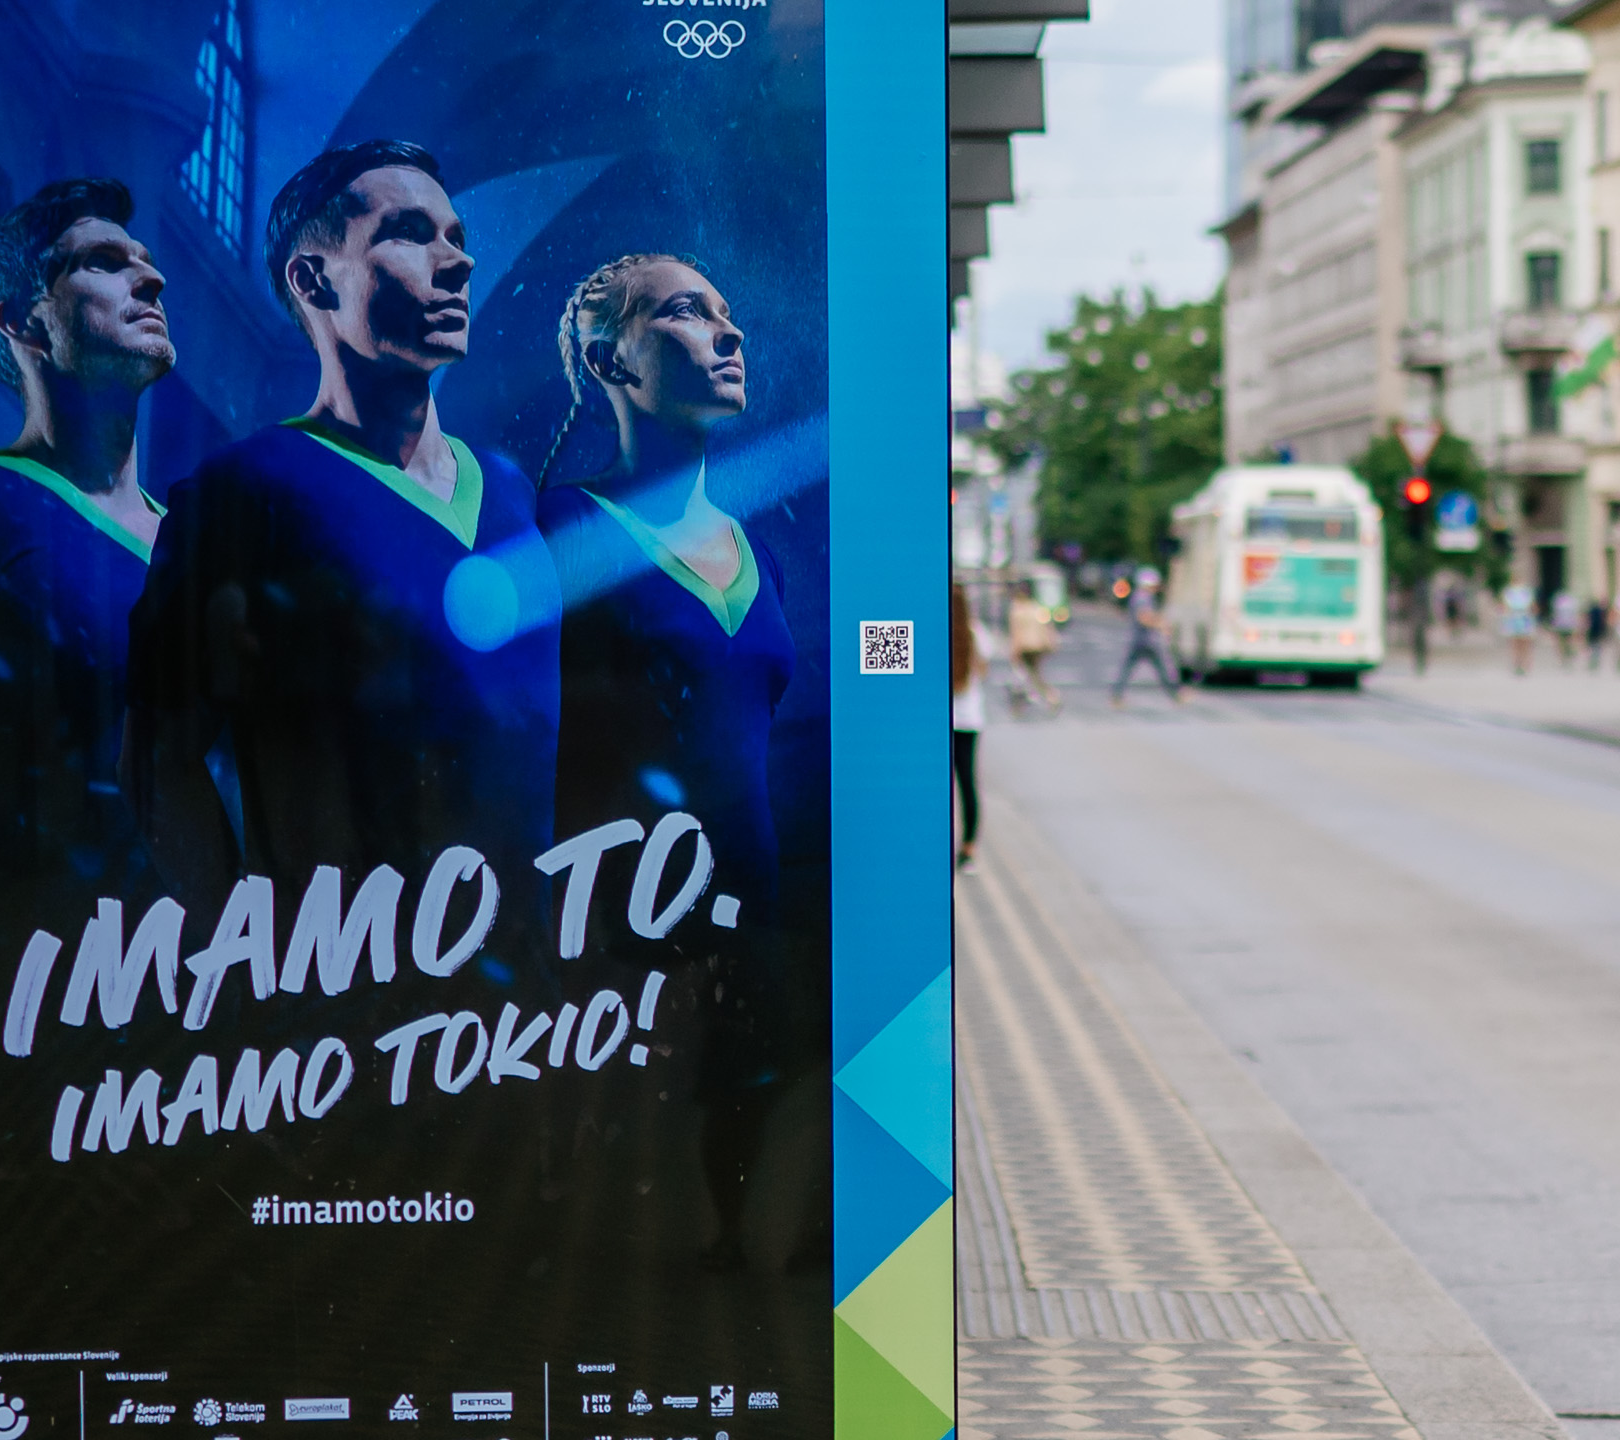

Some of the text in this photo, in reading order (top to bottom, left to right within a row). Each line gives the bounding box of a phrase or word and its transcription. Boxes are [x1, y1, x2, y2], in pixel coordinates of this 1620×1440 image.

[3, 810, 742, 1059] IMAMO TO.
[50, 968, 668, 1163] IMAMO TOKIO!
[251, 1191, 475, 1226] #imamotokio
[577, 1363, 616, 1374] Sponzorji
[460, 1398, 506, 1407] PETROL
[591, 1394, 612, 1404] RTV
[224, 1403, 266, 1413] Telekom
[591, 1404, 612, 1413] SLO
[224, 1412, 266, 1423] Slovenije
[389, 1408, 420, 1421] PEAK
